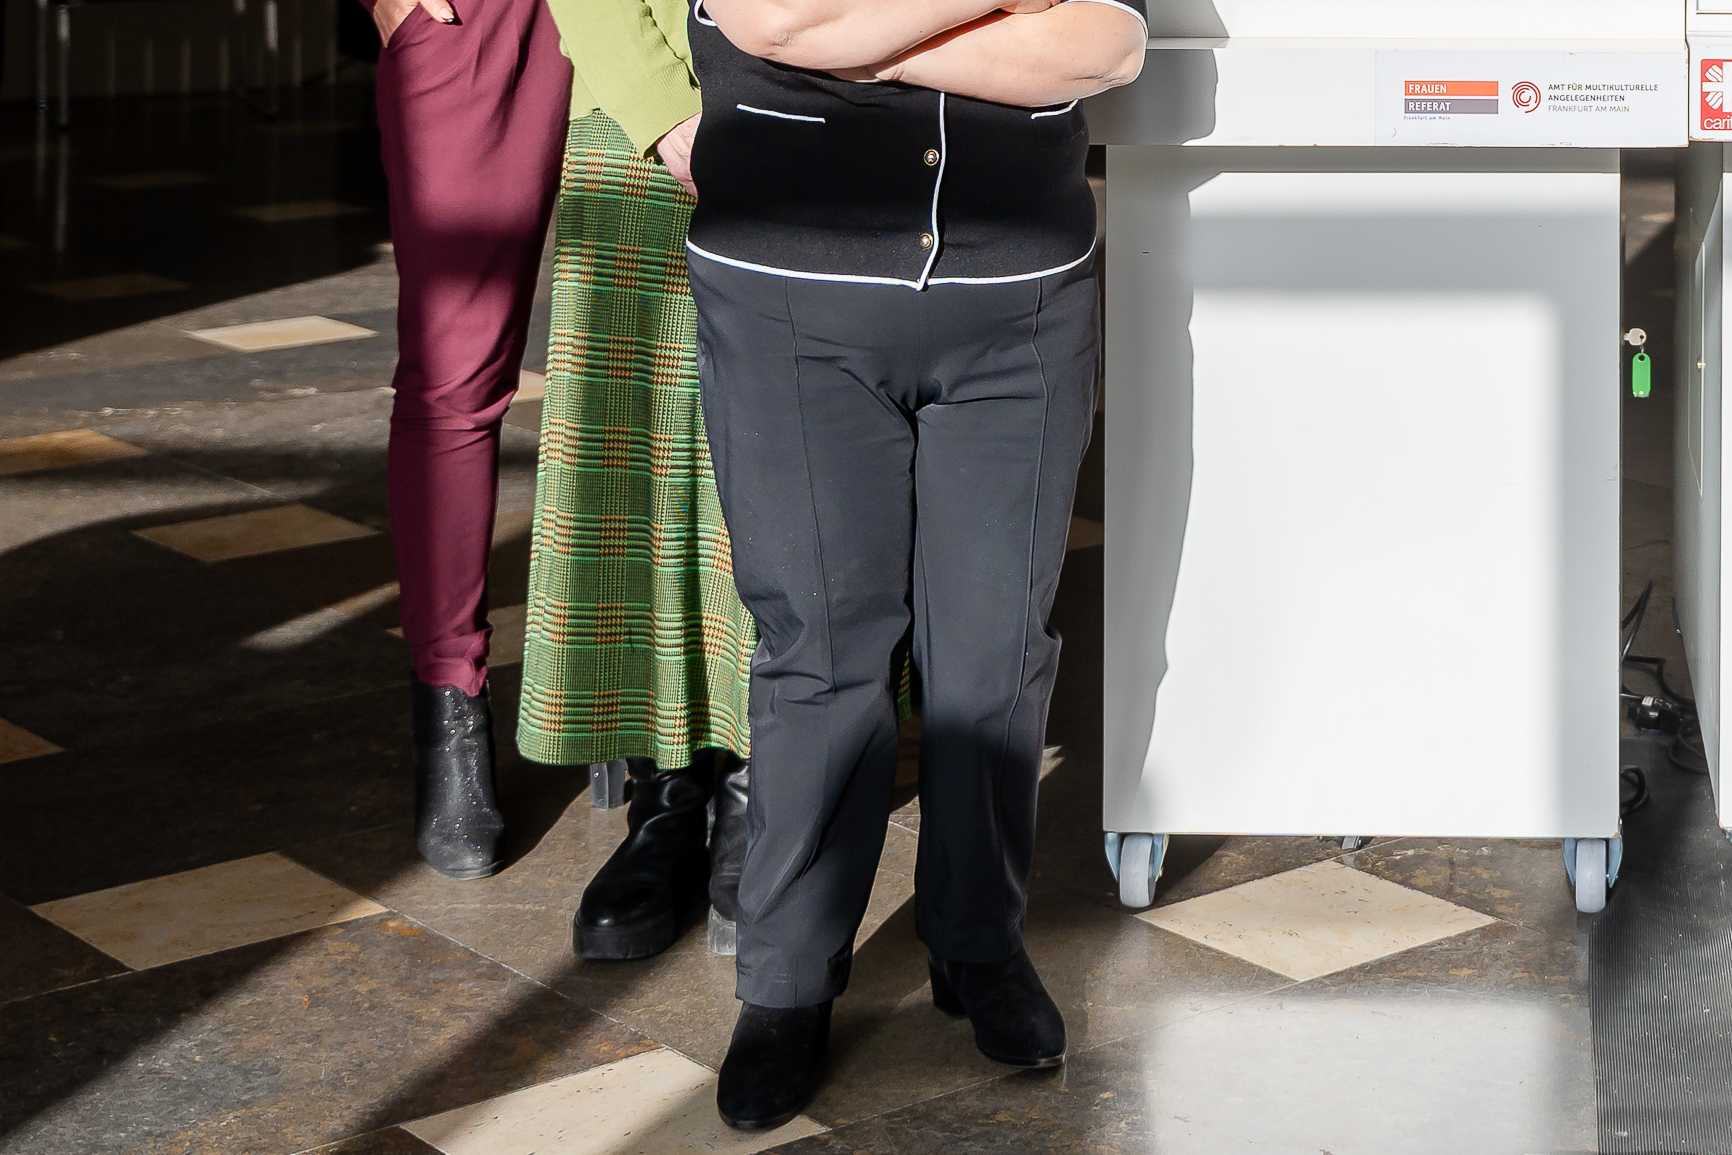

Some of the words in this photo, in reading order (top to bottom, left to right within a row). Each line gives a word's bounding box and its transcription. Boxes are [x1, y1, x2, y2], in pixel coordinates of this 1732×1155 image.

[1408, 84, 1447, 94] FRAUEN
[1568, 82, 1582, 90] FÜR
[1548, 94, 1624, 102] ANGELEGENHEITEN
[1408, 102, 1452, 111] REFERAT
